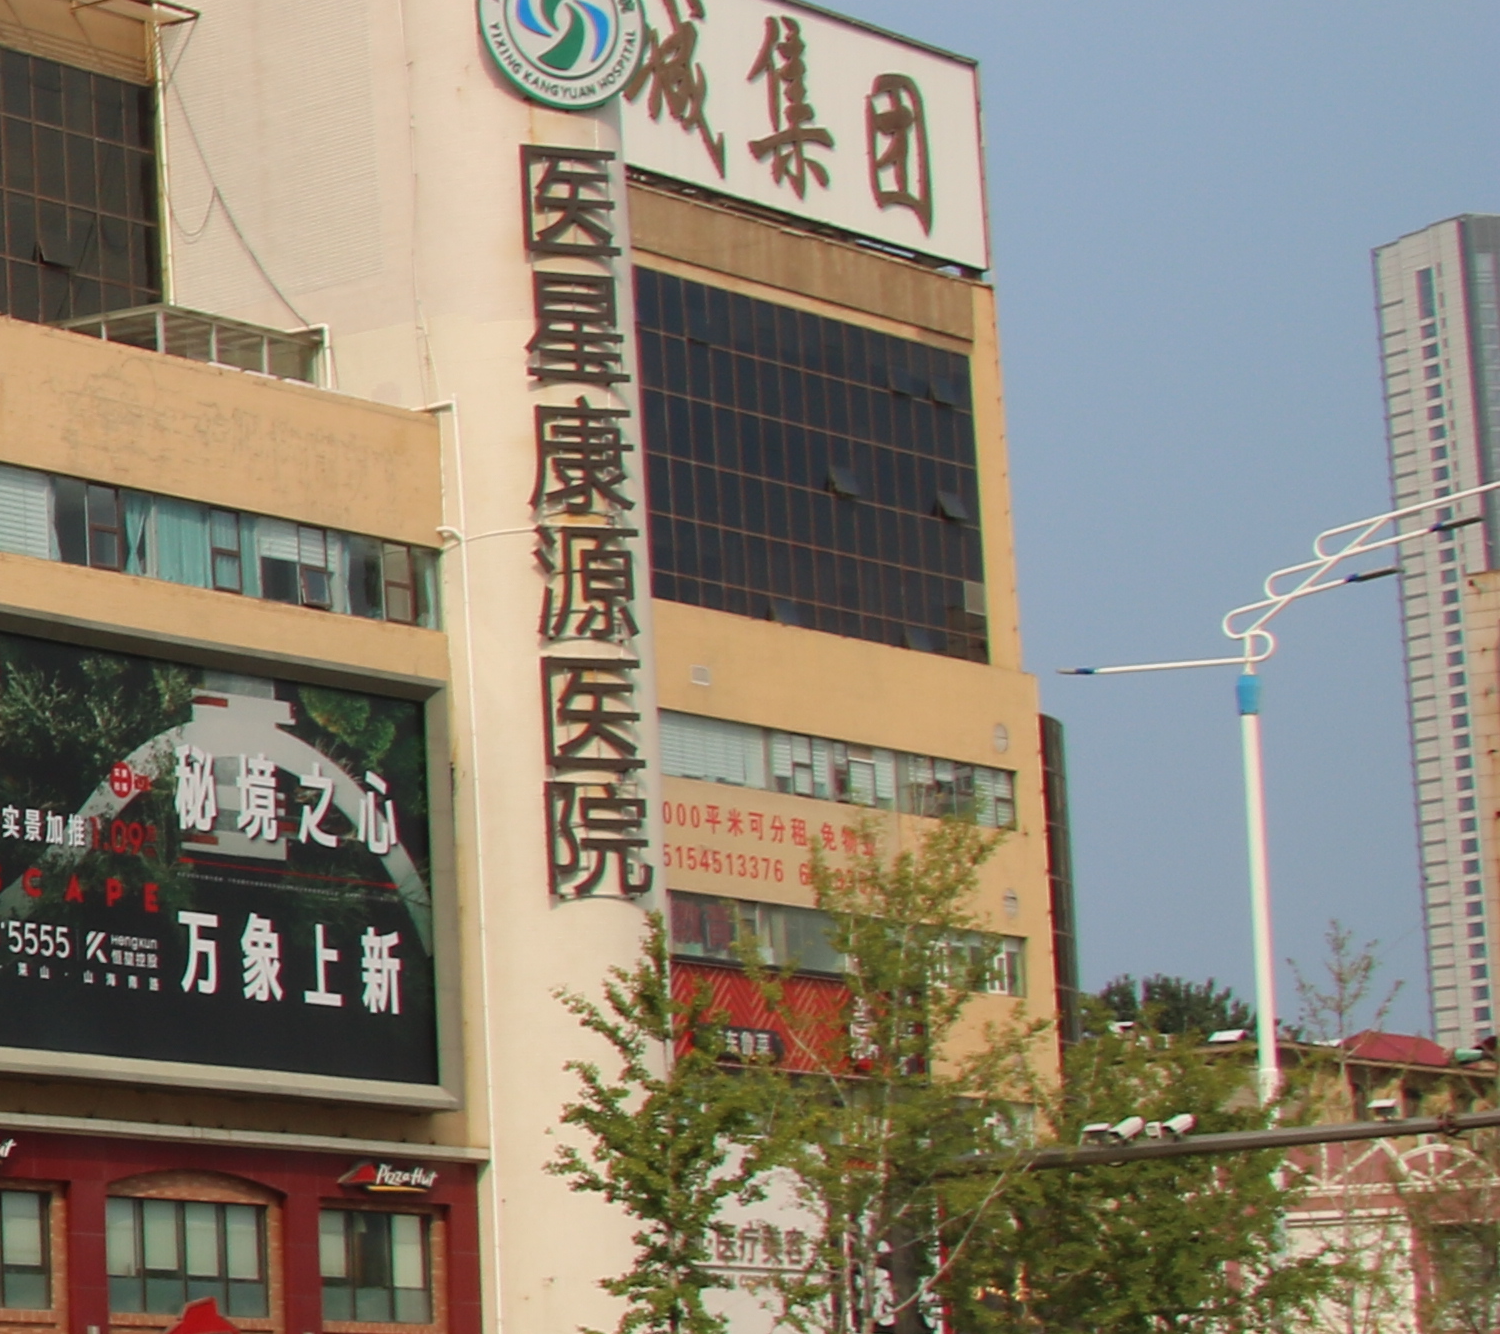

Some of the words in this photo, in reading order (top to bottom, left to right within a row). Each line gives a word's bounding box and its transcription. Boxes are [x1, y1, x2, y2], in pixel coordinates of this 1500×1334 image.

[489, 21, 522, 75] YIXING
[522, 73, 597, 99] KANGYUAN
[600, 29, 637, 91] HOSPITAL
[519, 143, 654, 901] 医星康源医院
[2, 803, 86, 848] 实景加推
[174, 743, 398, 856] 秘境之心
[176, 910, 401, 1016] 万象上新
[376, 1163, 411, 1185] Pizza
[410, 1167, 439, 1188] Hut
